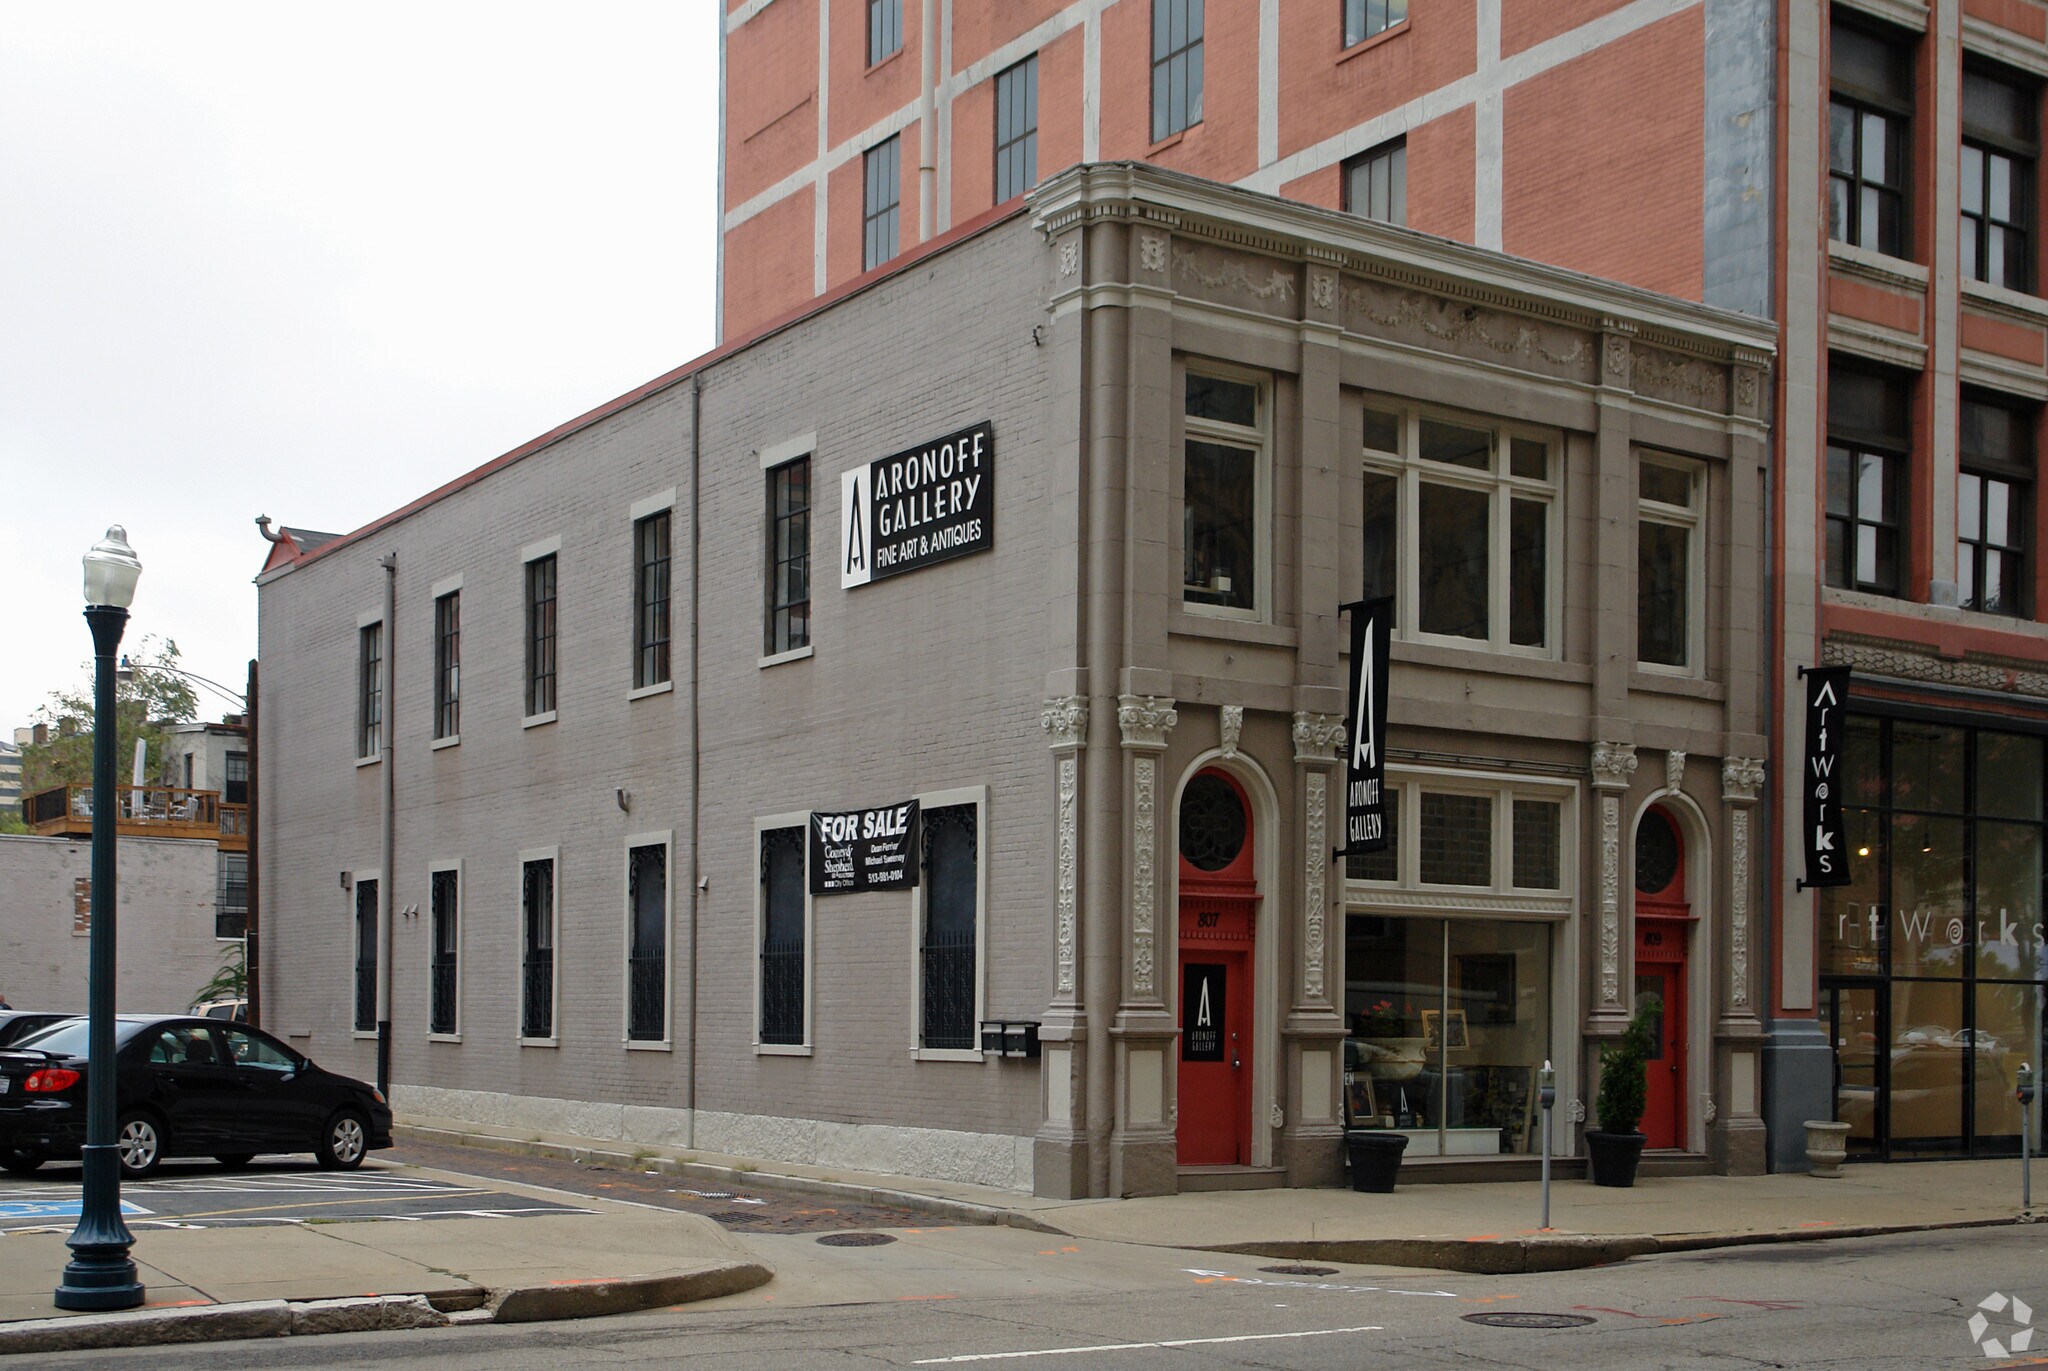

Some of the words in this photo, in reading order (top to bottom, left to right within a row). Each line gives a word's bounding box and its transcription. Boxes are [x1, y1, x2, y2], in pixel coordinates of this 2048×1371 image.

[876, 432, 984, 501] ARONOFF
[846, 475, 866, 575] A
[880, 474, 982, 537] GALLERY
[877, 544, 897, 568] FINE
[899, 538, 918, 562] ART
[920, 535, 929, 556] &
[930, 518, 982, 554] ANTIQUES
[1353, 616, 1376, 770] A
[1349, 778, 1379, 808] ARONOFF
[821, 814, 859, 842] FOR
[863, 807, 907, 839] SALE
[1350, 813, 1381, 842] GALLERY
[1197, 912, 1220, 928] 807
[1838, 906, 2045, 949] rtWorks
[1197, 976, 1211, 1027] A
[1192, 1031, 1216, 1041] ARONOFF
[1192, 1041, 1216, 1051] GALLERY
[1344, 1072, 1354, 1086] EN
